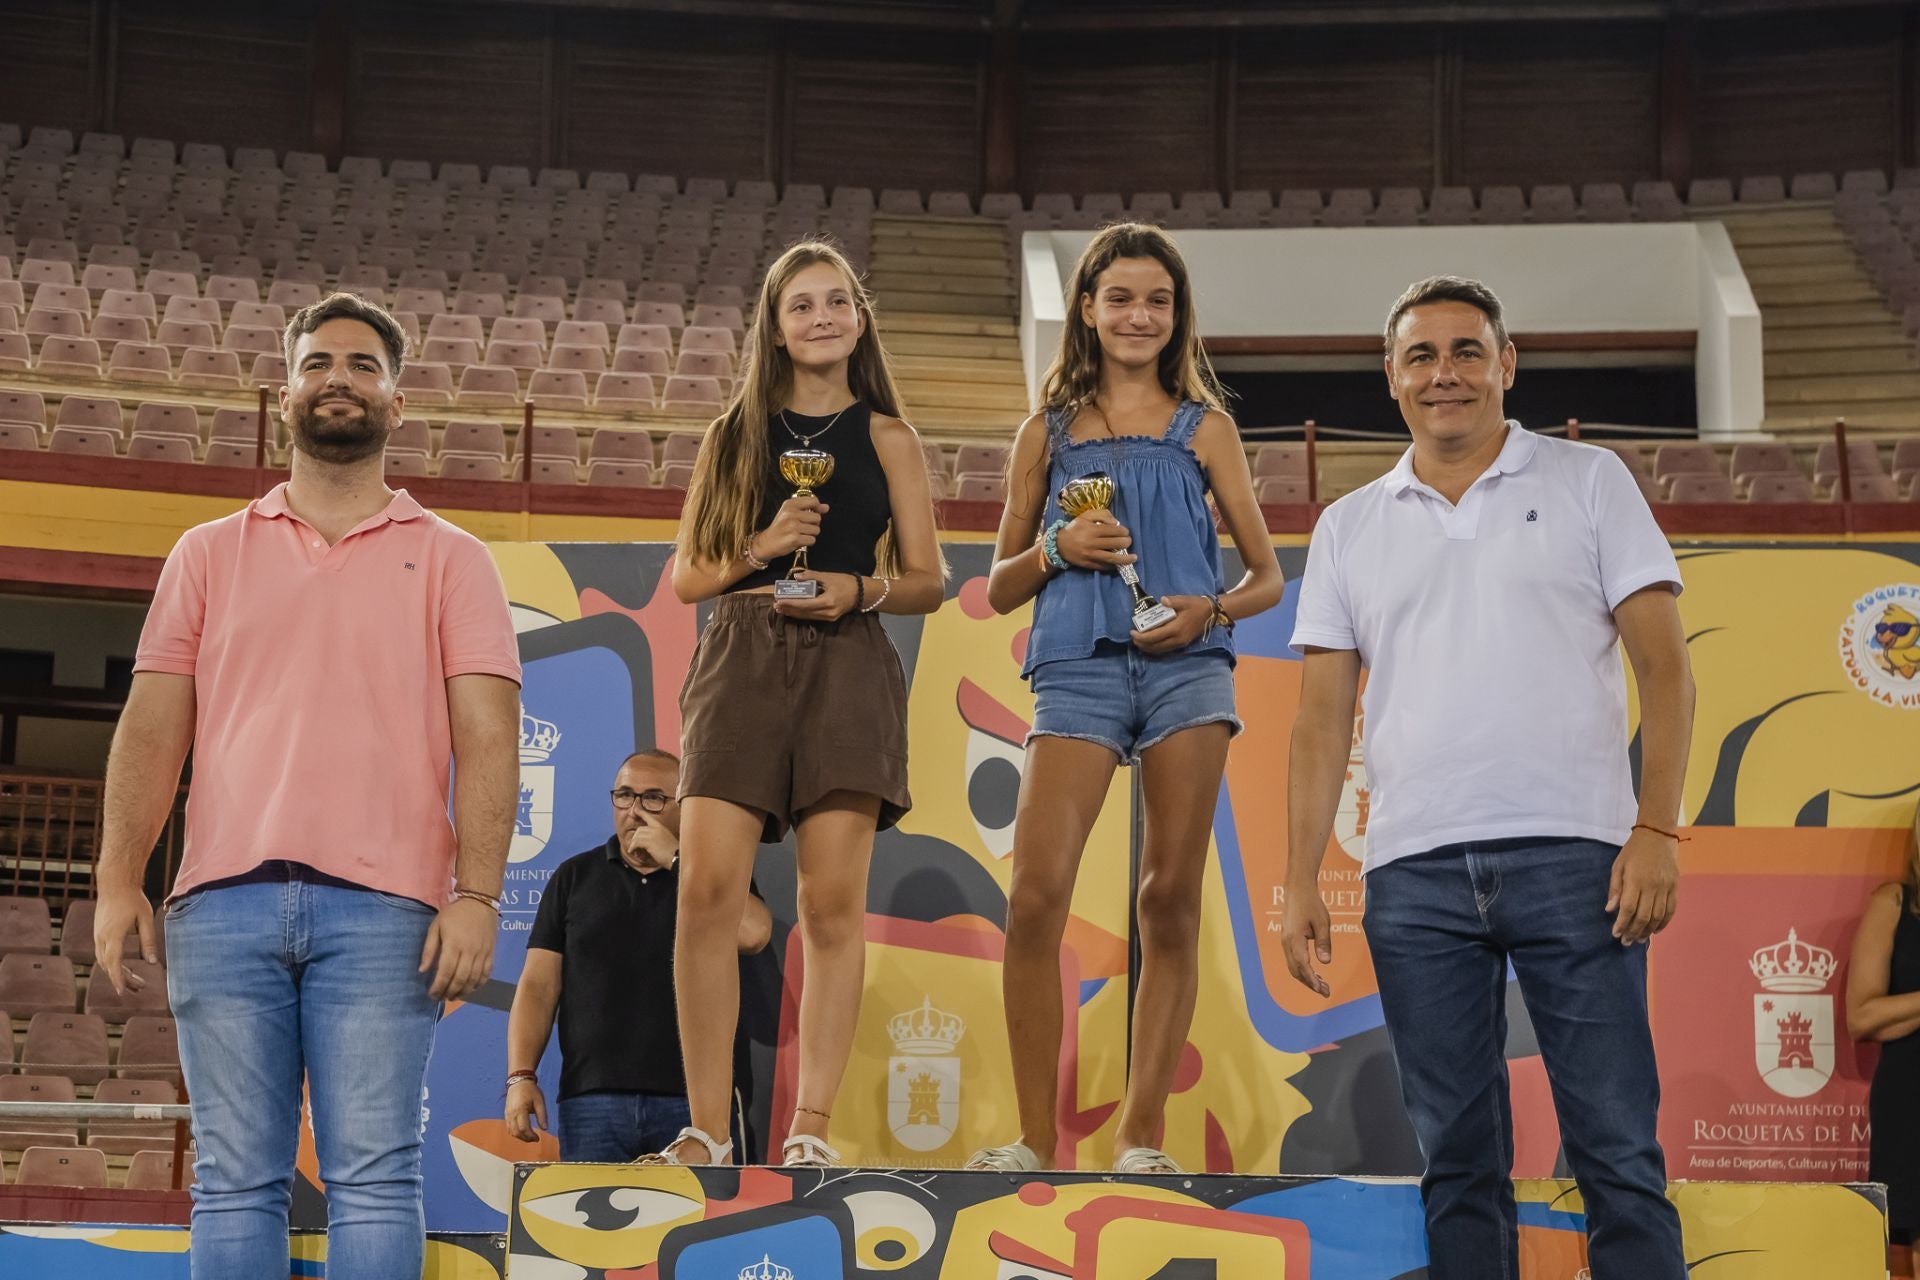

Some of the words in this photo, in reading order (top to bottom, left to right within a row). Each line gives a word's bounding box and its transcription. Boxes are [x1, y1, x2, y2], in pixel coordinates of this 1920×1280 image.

[1856, 586, 1920, 613] ROQUET
[1872, 687, 1893, 704] LA
[1728, 1103, 1844, 1117] AYUNTAMIENTO
[1815, 1125, 1840, 1142] DE
[1716, 1156, 1731, 1168] de
[1733, 1156, 1786, 1170] Deportes,
[1788, 1156, 1828, 1169] Cultura
[1829, 1160, 1838, 1172] y
